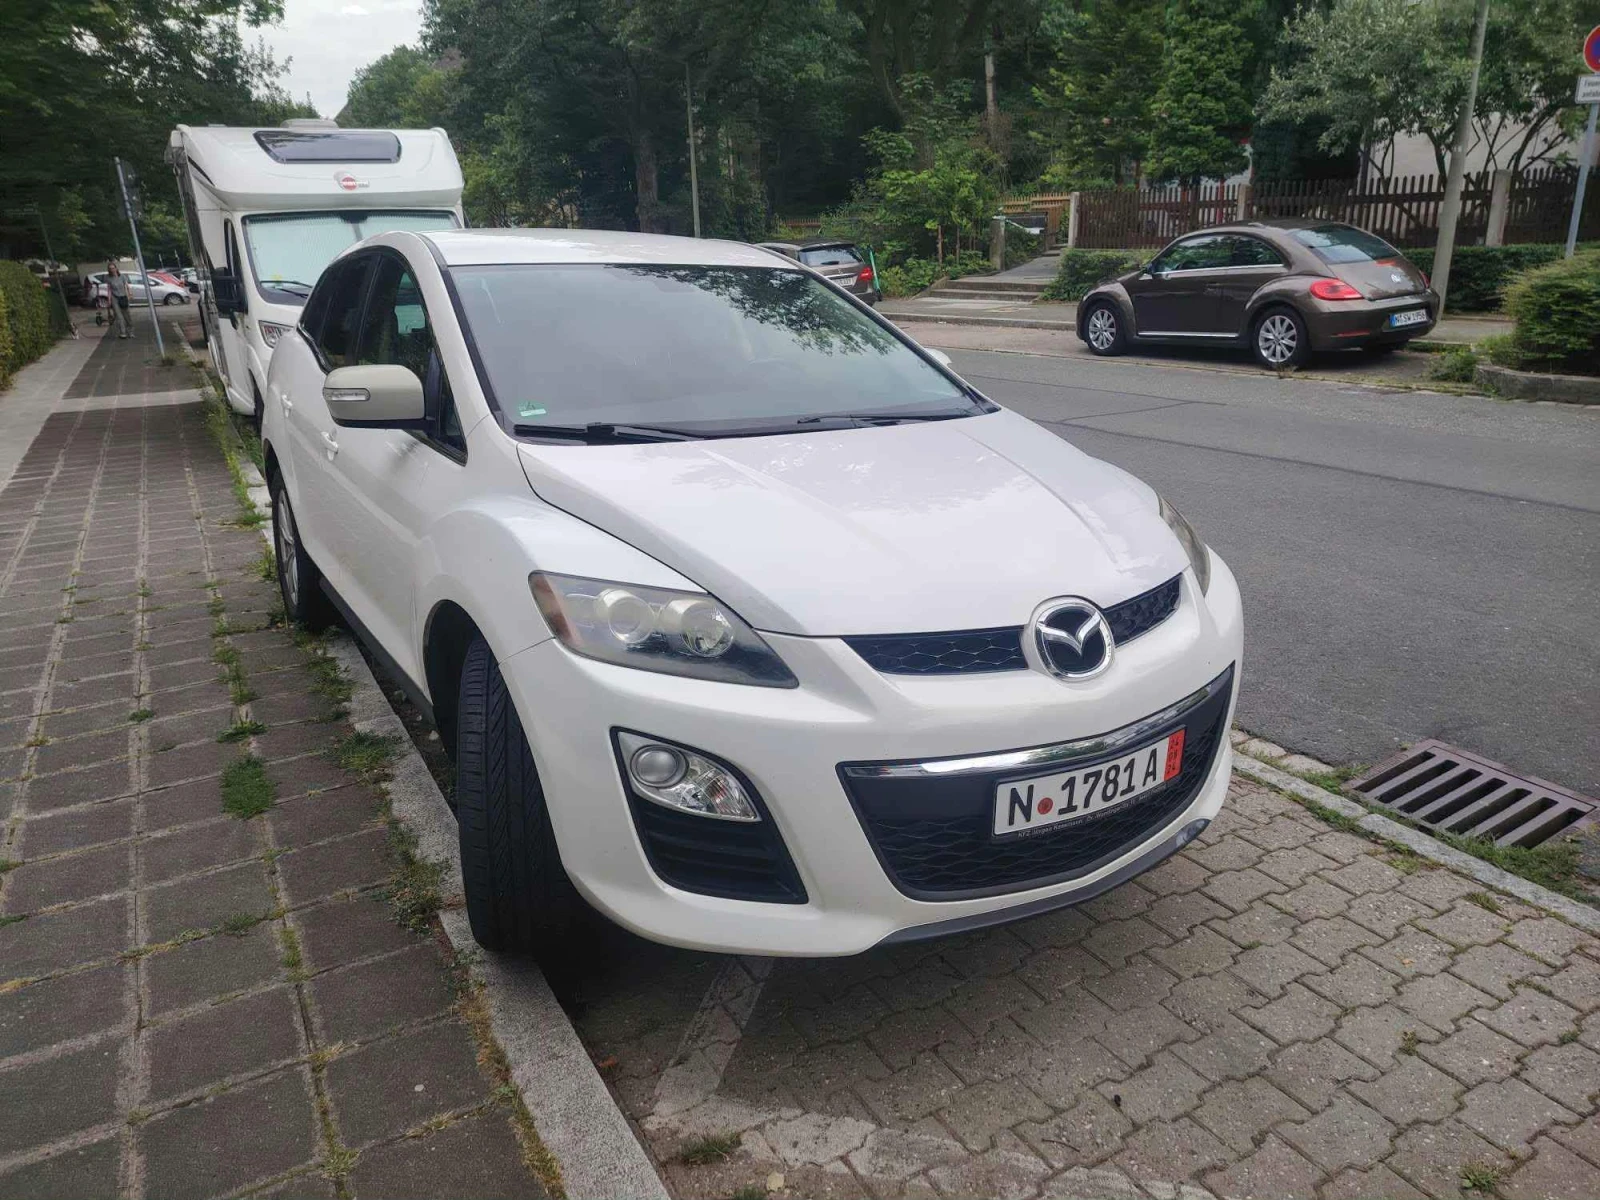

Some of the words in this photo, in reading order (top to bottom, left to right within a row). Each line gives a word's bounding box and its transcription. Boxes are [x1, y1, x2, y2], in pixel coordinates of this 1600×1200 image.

[1008, 784, 1034, 826] N
[1057, 757, 1136, 815] 1781
[1142, 748, 1157, 786] A
